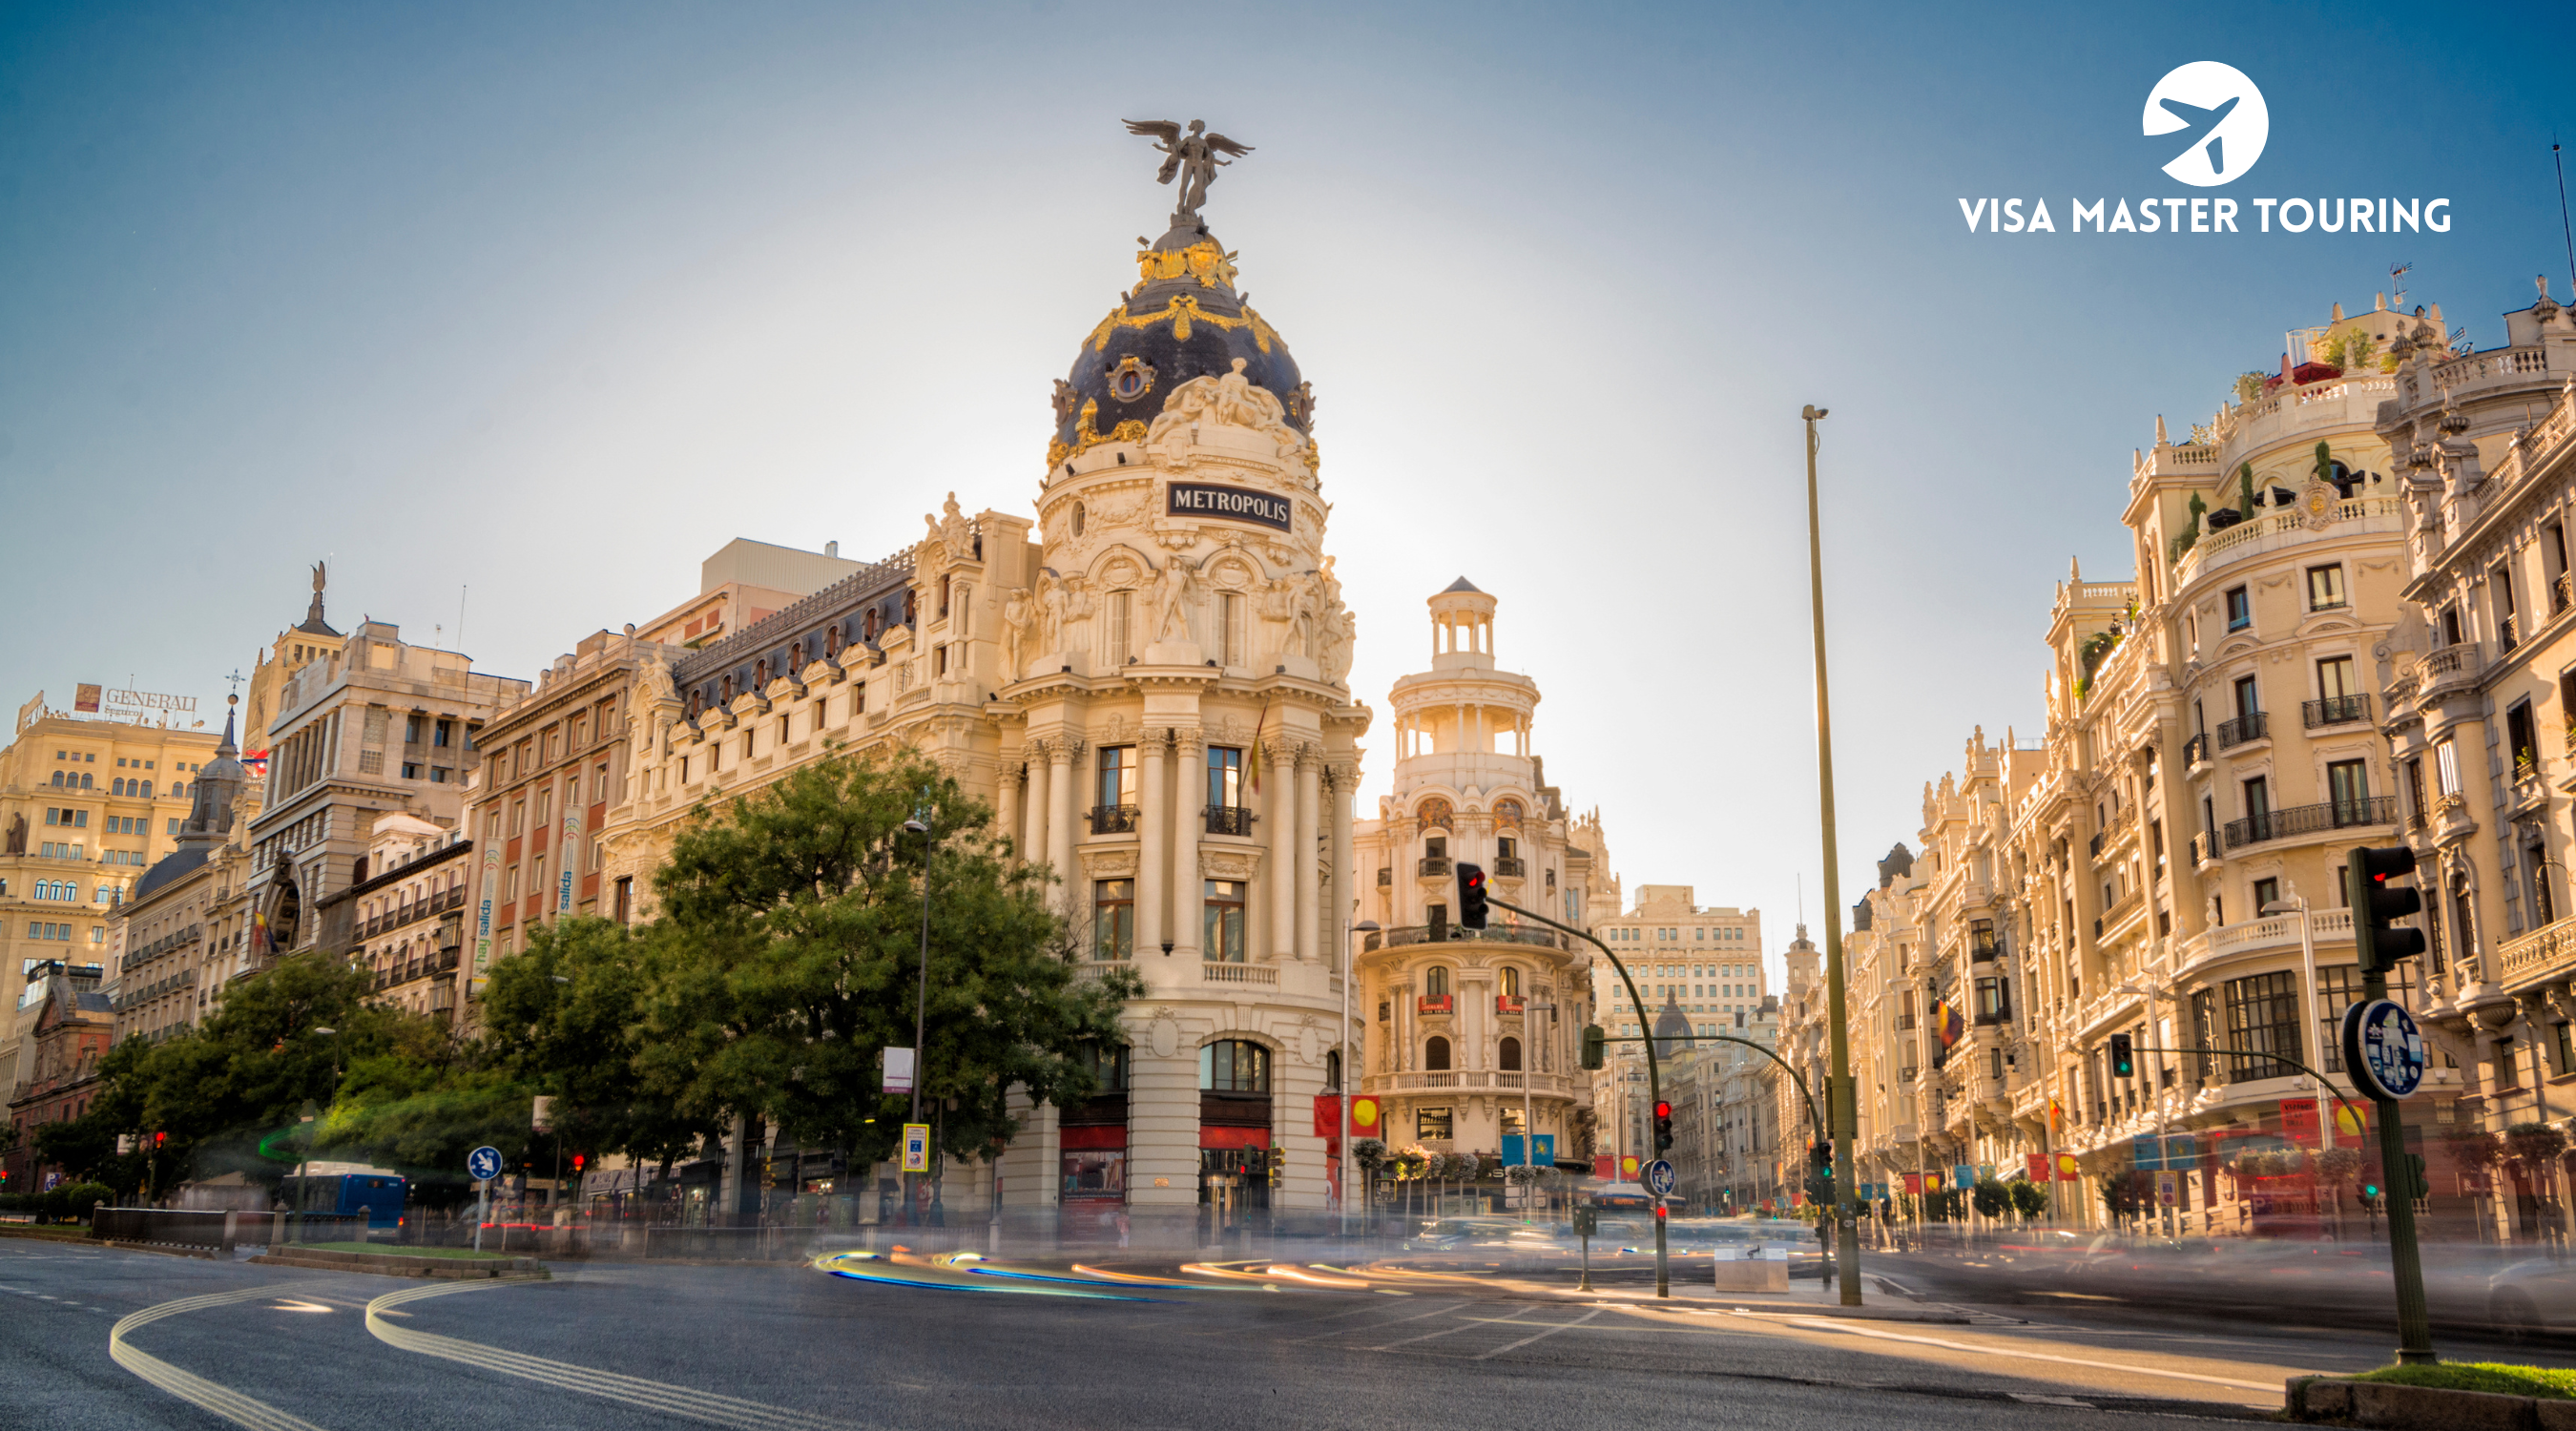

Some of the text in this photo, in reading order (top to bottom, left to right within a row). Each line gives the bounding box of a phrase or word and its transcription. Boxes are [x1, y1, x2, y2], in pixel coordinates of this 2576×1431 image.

[1174, 489, 1288, 523] METROPOLIS
[106, 689, 197, 712] GENERALI
[559, 870, 572, 910] salida
[479, 900, 492, 936] salida
[475, 939, 491, 963] hay
